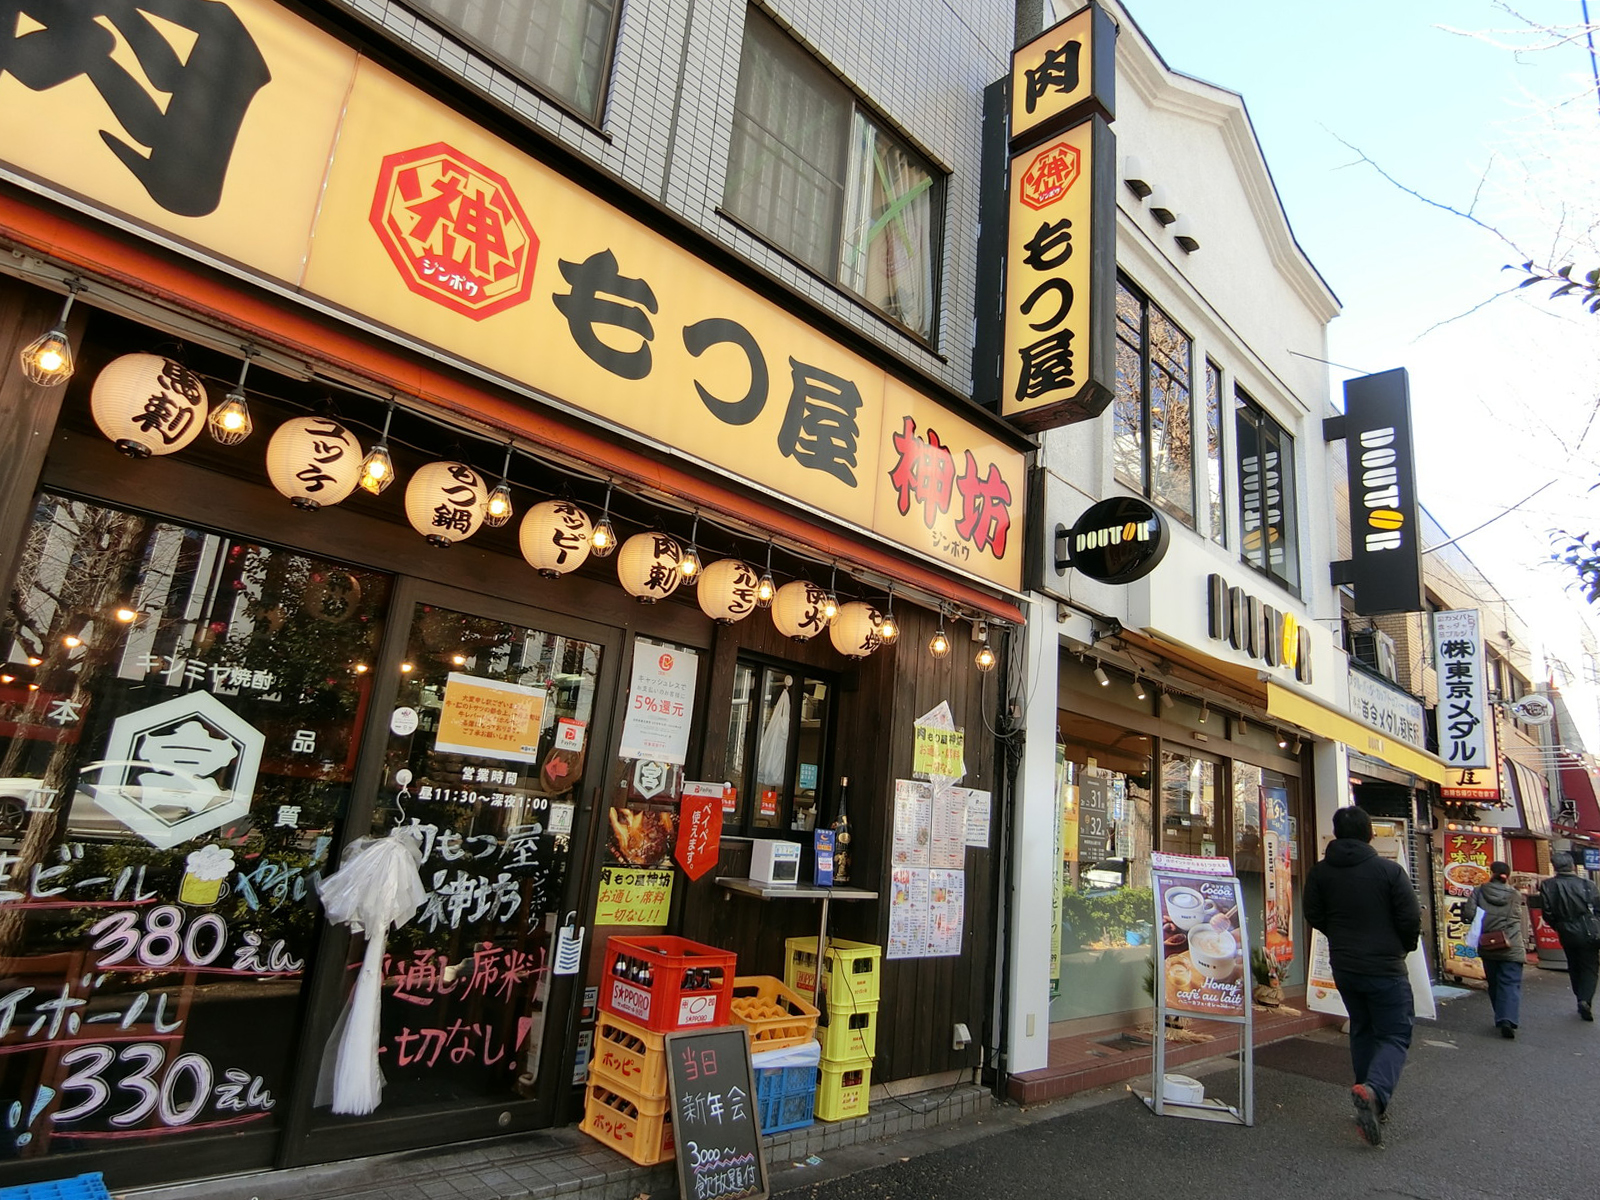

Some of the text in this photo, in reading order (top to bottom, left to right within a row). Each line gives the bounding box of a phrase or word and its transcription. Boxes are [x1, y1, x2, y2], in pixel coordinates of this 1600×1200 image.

[1024, 41, 1081, 114] 肉
[1030, 152, 1071, 194] 神
[402, 162, 511, 276] 神
[1014, 217, 1076, 402] もつ屋
[552, 247, 864, 488] もつ屋
[432, 464, 478, 534] もつ鍋
[887, 415, 1012, 559] 神坊
[1360, 426, 1405, 552] DOUTOR
[552, 502, 587, 564] ホッピー
[1076, 522, 1150, 552] DOUTOR
[644, 536, 680, 594] 肉刺
[728, 562, 757, 614] ホルモン
[1207, 573, 1313, 685] DOUTOR
[136, 651, 274, 691] キンミヤ焼酎
[638, 675, 687, 691] キャッシュレスで
[634, 694, 684, 717] 5%還元
[636, 685, 686, 699] お支払いのお客様に
[48, 699, 81, 725] 本
[291, 729, 316, 754] 品
[461, 766, 518, 786] 営業時間
[1443, 789, 1496, 798] お持ち帰りできます
[274, 804, 302, 829] 質
[697, 803, 712, 855] ペイペイ
[687, 810, 701, 870] 使えます。
[1452, 835, 1487, 849] チゲ
[1450, 850, 1487, 866] 味噌
[599, 868, 671, 887] 肉もつ屋神坊
[1200, 882, 1233, 896] Cocoa
[417, 868, 522, 934] 神坊
[1176, 988, 1241, 1004] café au lait
[1202, 976, 1238, 995] Honey
[602, 1049, 641, 1077] ホッピー
[682, 1046, 718, 1081] 当日
[682, 1085, 747, 1126] 新年会
[593, 1112, 634, 1141] ホッピー
[695, 1164, 756, 1199] 飲放題付
